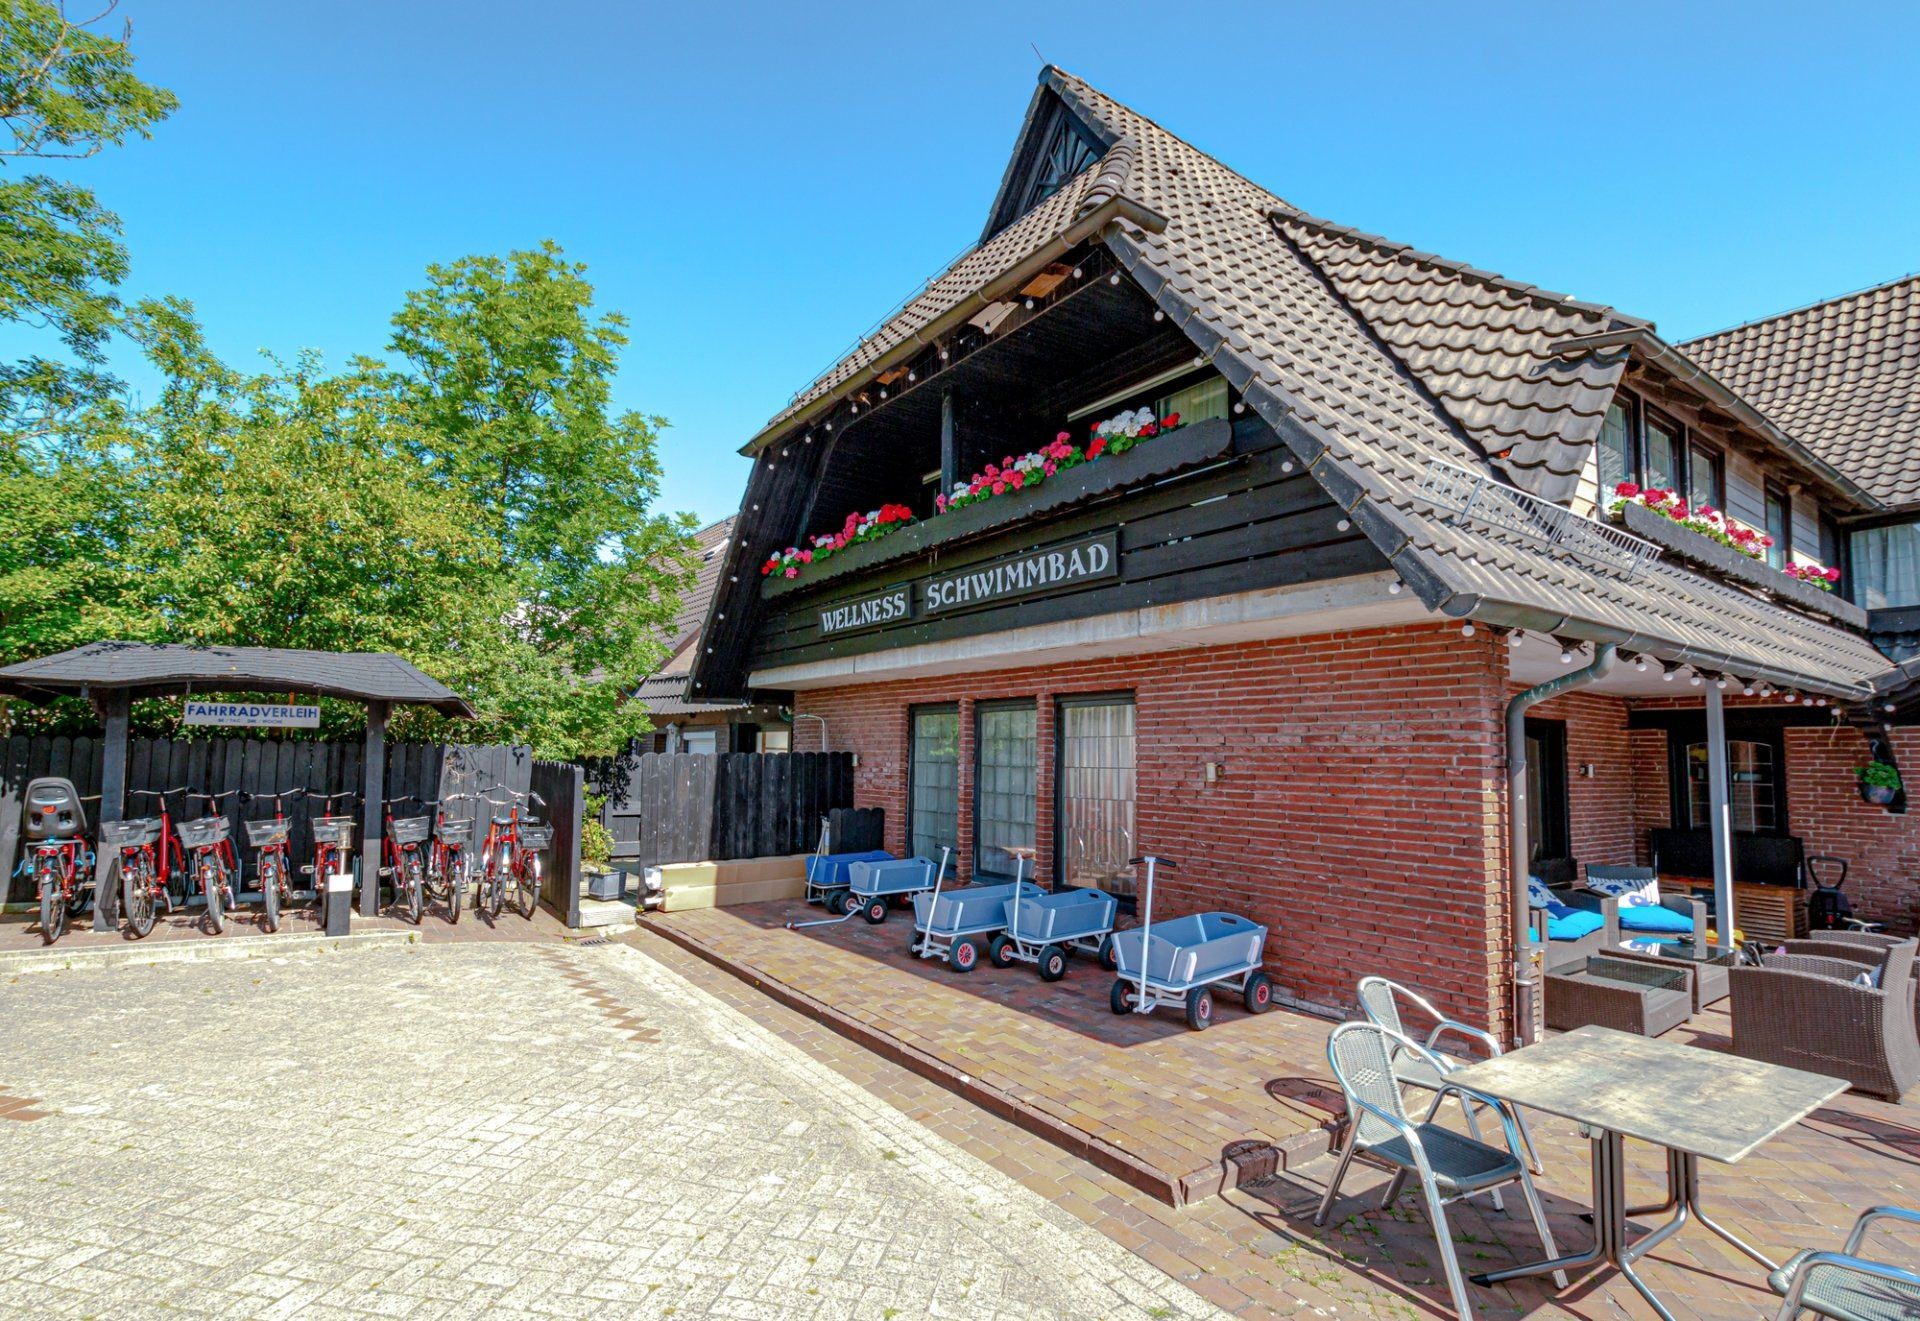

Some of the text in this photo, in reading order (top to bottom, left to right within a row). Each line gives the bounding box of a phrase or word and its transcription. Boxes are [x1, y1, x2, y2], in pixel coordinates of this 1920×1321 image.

[927, 543, 1109, 609] SCHWIMMBAD
[821, 593, 906, 632] WELLNESS
[187, 704, 317, 718] FAHRRADVERLEIH
